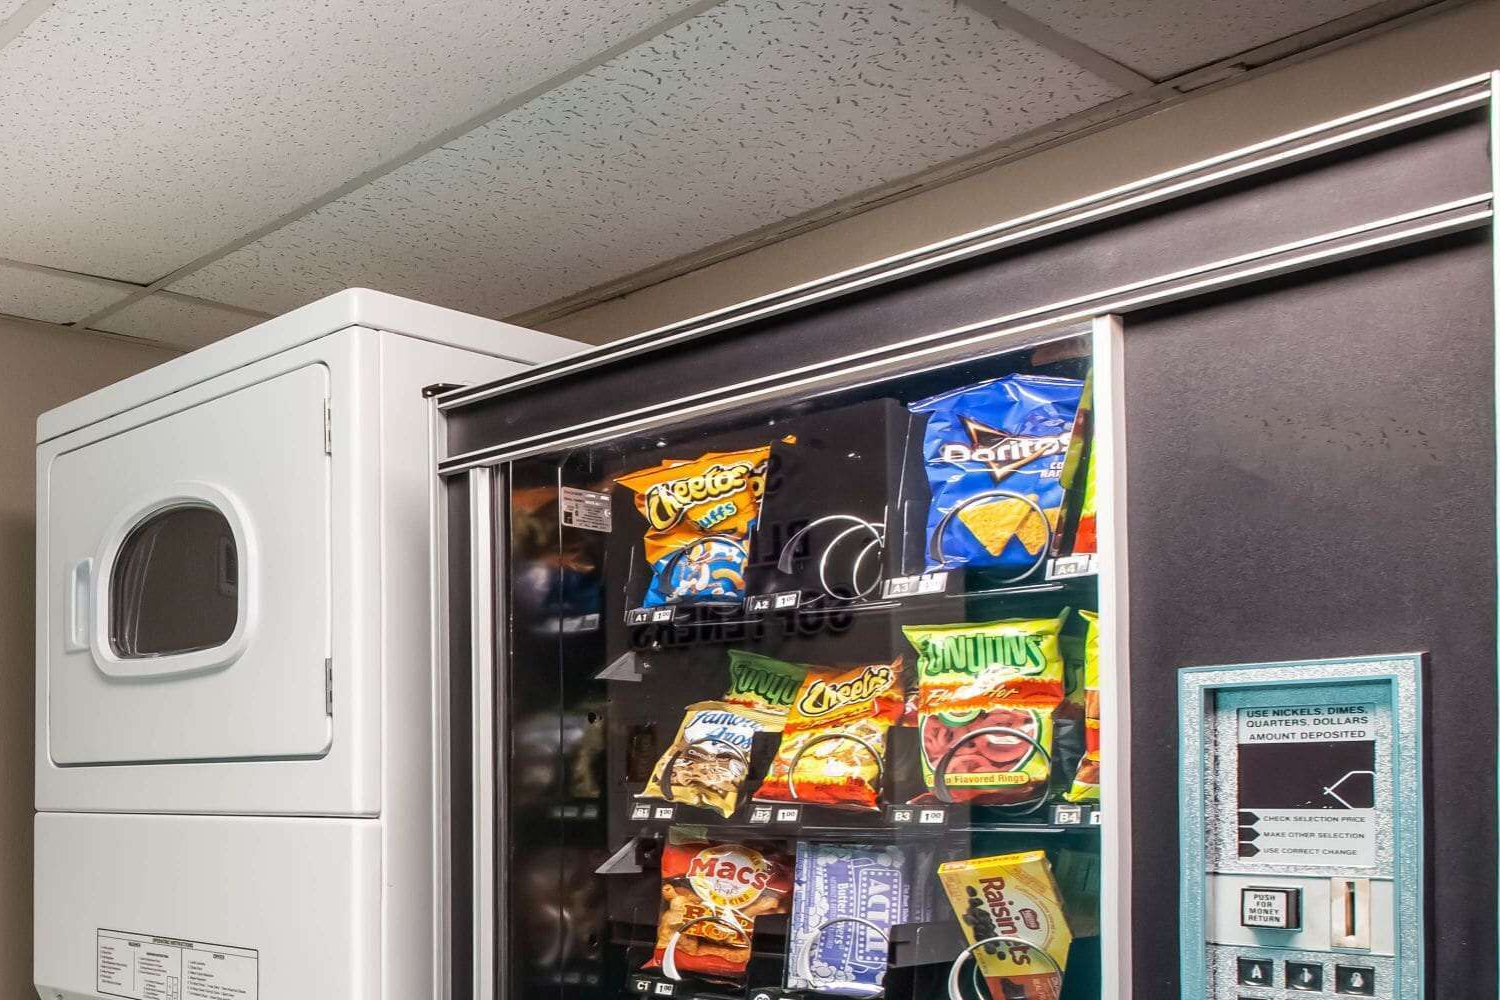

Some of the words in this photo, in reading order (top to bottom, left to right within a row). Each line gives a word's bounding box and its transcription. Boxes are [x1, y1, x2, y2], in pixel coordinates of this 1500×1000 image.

[645, 460, 755, 532] Cheetos
[699, 502, 735, 528] uffs
[753, 600, 770, 610] A2
[635, 612, 648, 623] A1
[798, 665, 895, 717] Cheetos
[1246, 707, 1269, 718] USE
[1313, 715, 1369, 726] DOLLARS
[1249, 731, 1296, 741] AMOUNT
[1300, 729, 1366, 740] DEPOSITED
[894, 811, 909, 821] B3
[1060, 812, 1077, 822] B4
[1263, 815, 1290, 823] CHECK
[837, 882, 849, 914] Butter
[867, 879, 891, 923] ACT
[1253, 893, 1276, 901] PUSH
[1256, 900, 1273, 908] FOR
[1249, 907, 1280, 916] MONEY
[1248, 914, 1281, 923] RETURN
[1251, 967, 1262, 979] A
[637, 981, 650, 991] C1
